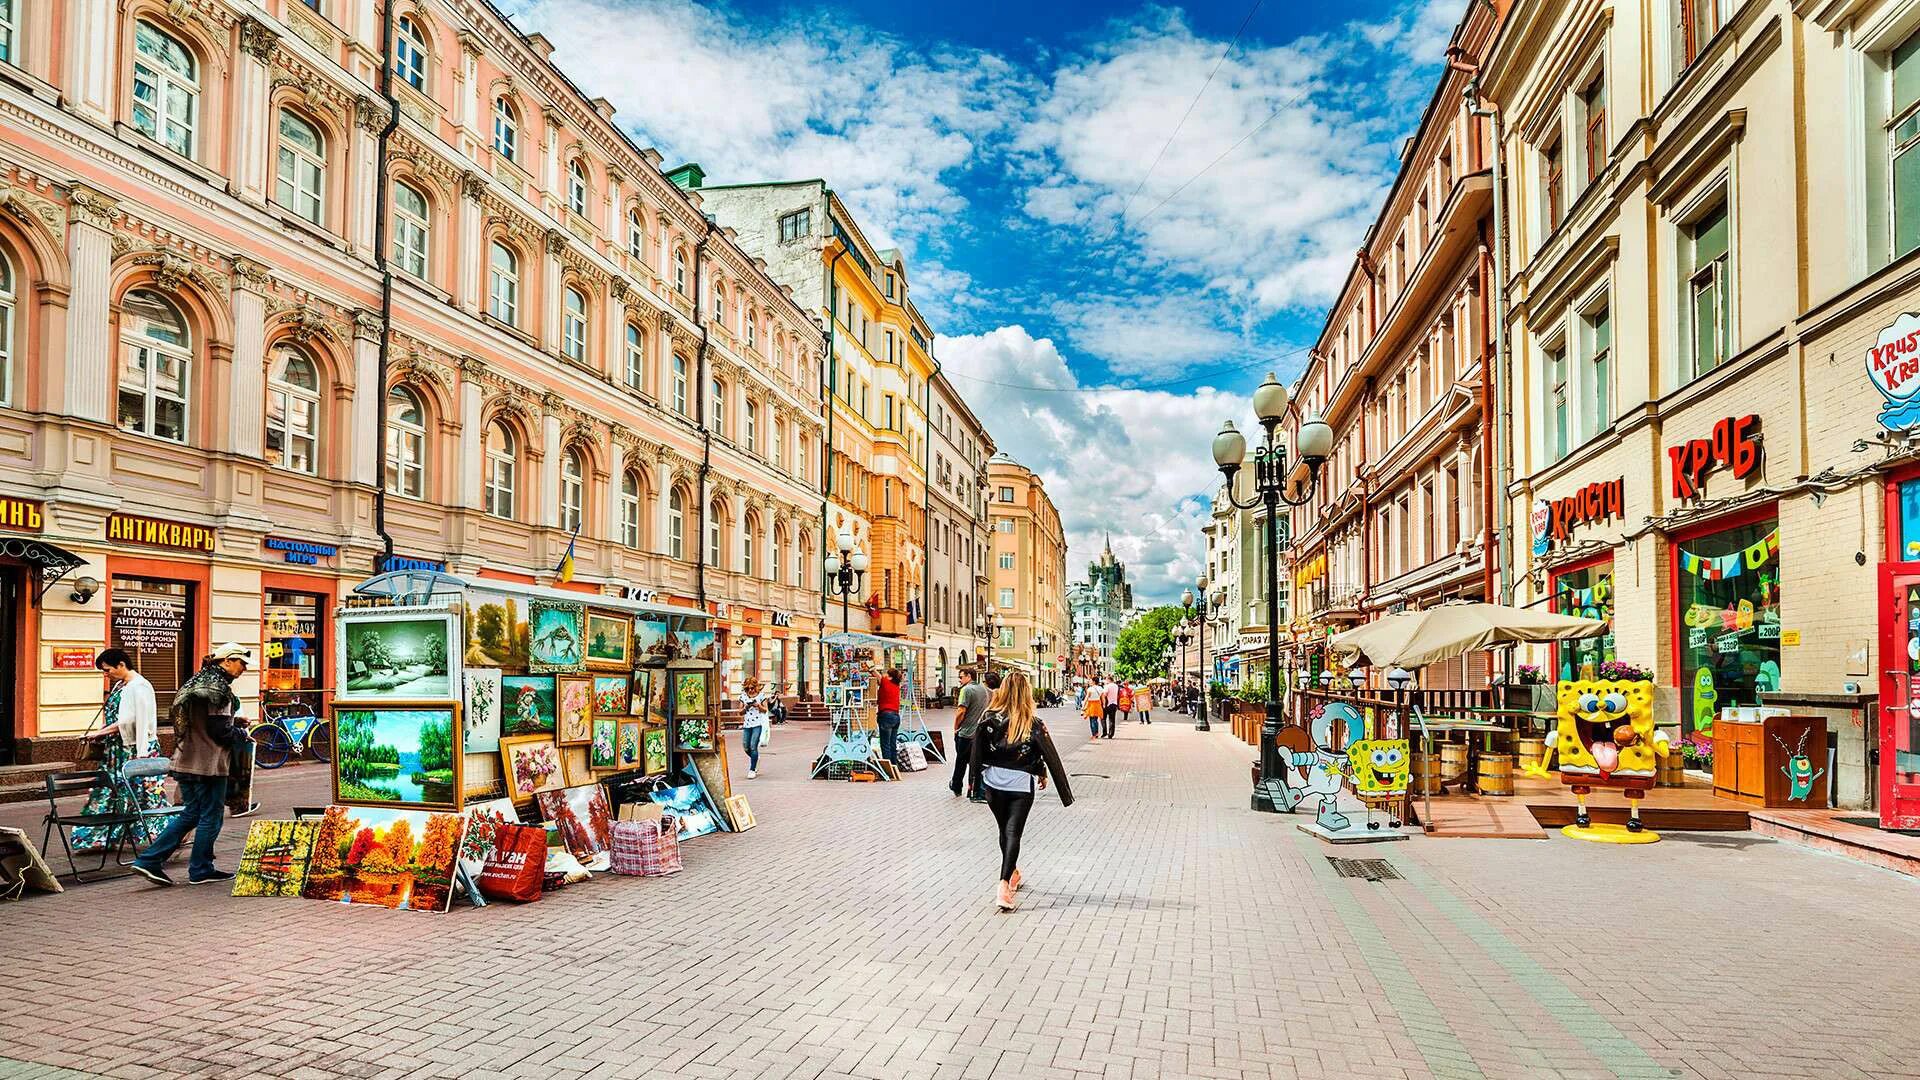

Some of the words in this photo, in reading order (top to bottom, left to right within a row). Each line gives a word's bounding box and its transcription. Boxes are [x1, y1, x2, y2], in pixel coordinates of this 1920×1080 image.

[109, 516, 215, 550] АНТИКВАРЪ
[268, 539, 337, 556] НАСТОЛЬНЫЕ
[286, 552, 318, 564] ИГРЫ
[627, 587, 658, 602] KFC
[128, 598, 172, 608] ОЦЕНКА
[123, 608, 175, 618] ПОКУПКА
[775, 611, 793, 627] KFC
[115, 617, 182, 627] АНТИКВАРИАТ
